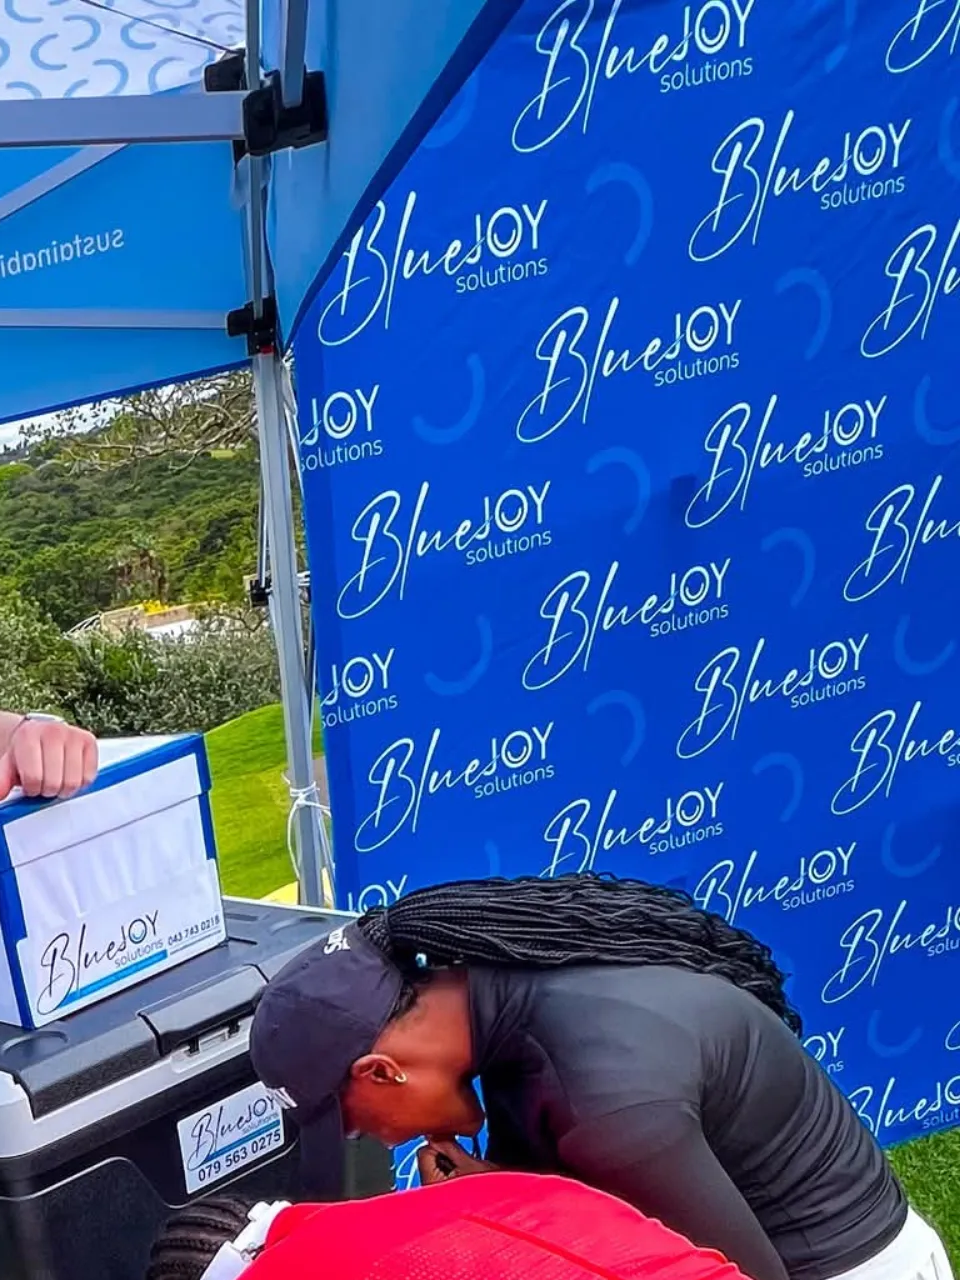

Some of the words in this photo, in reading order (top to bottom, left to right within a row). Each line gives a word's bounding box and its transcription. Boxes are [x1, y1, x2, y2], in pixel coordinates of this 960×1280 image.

[660, 57, 753, 92] solutions
[820, 174, 906, 210] solutions
[455, 256, 548, 294] solutions
[654, 351, 740, 387] solutions
[803, 444, 884, 477] solutions
[466, 530, 552, 565] solutions
[650, 603, 729, 637] solutions
[790, 675, 866, 709] solutions
[474, 763, 555, 798] solutions
[649, 822, 723, 855] solutions
[781, 876, 855, 910] solutions
[115, 939, 164, 968] solutions
[198, 1160, 221, 1182] 079
[225, 1147, 248, 1168] 563
[251, 1129, 281, 1154] 0275
